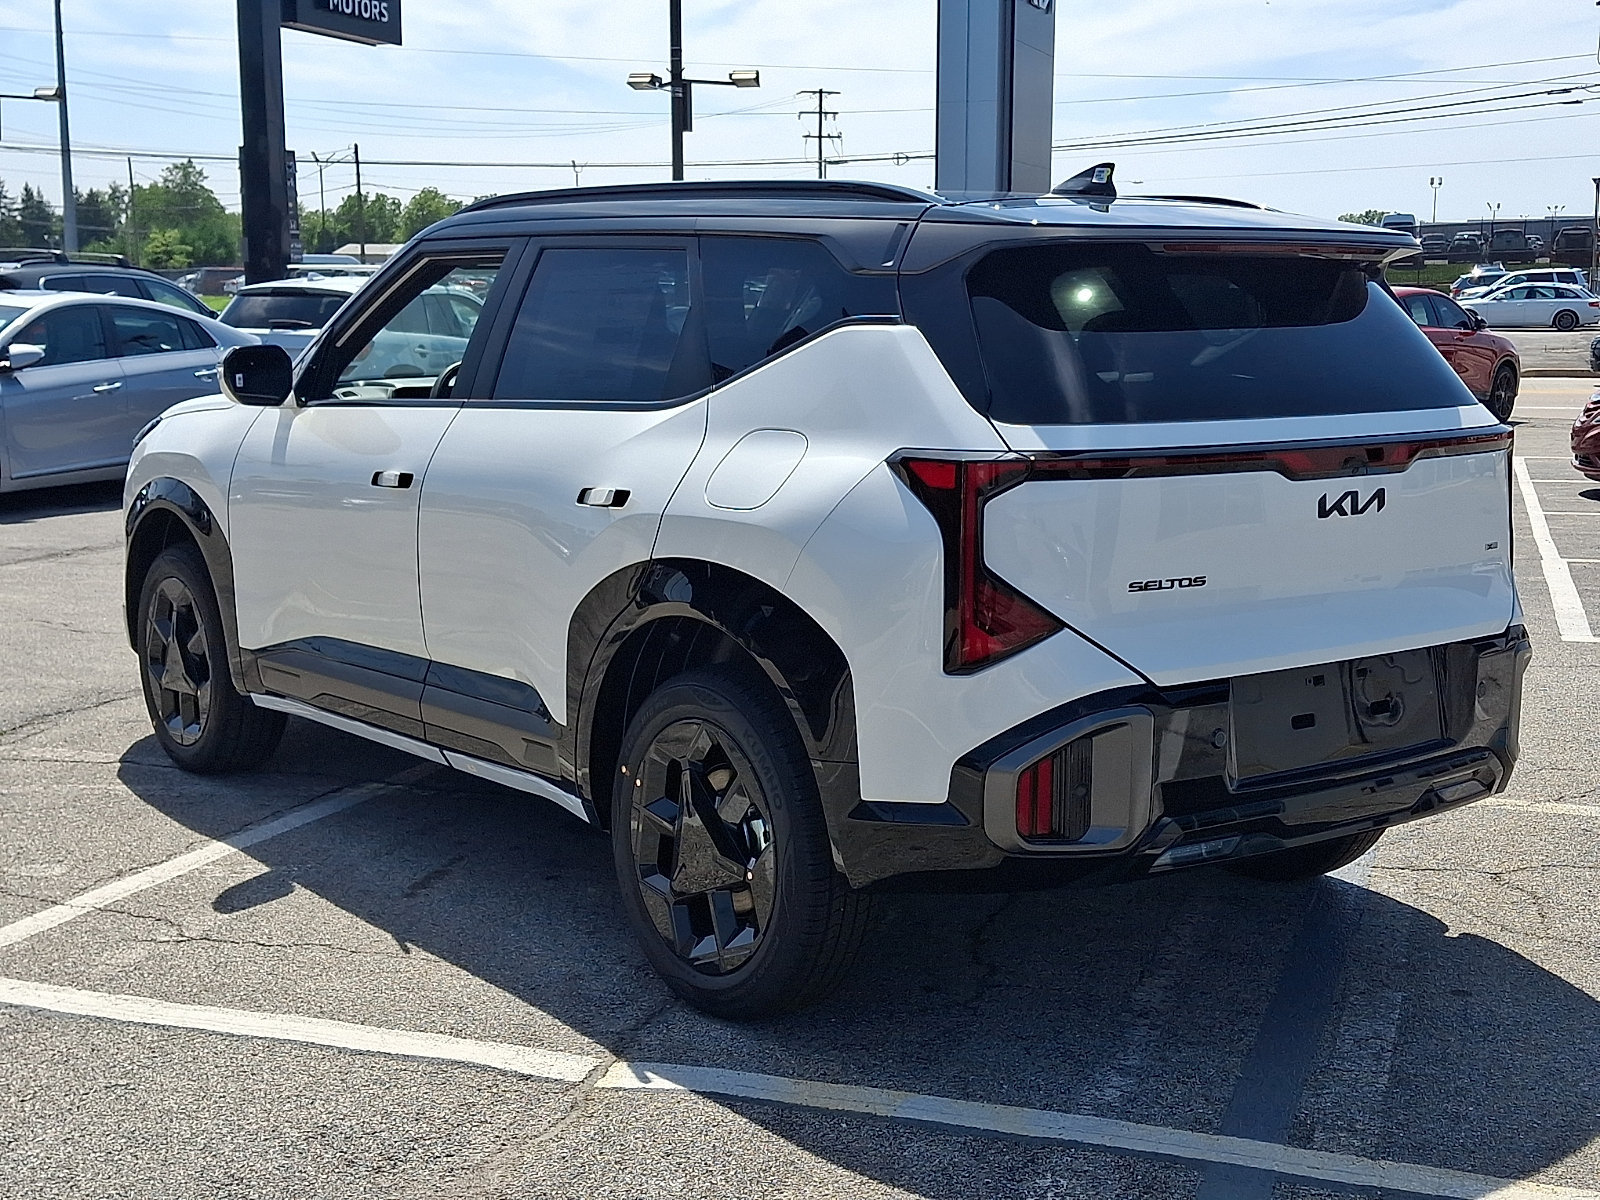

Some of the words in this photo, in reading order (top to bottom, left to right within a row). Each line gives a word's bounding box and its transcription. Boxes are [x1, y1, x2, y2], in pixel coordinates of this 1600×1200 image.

[329, 0, 389, 23] MOTORS
[1317, 487, 1386, 519] KIA
[1128, 575, 1207, 593] SELTOS
